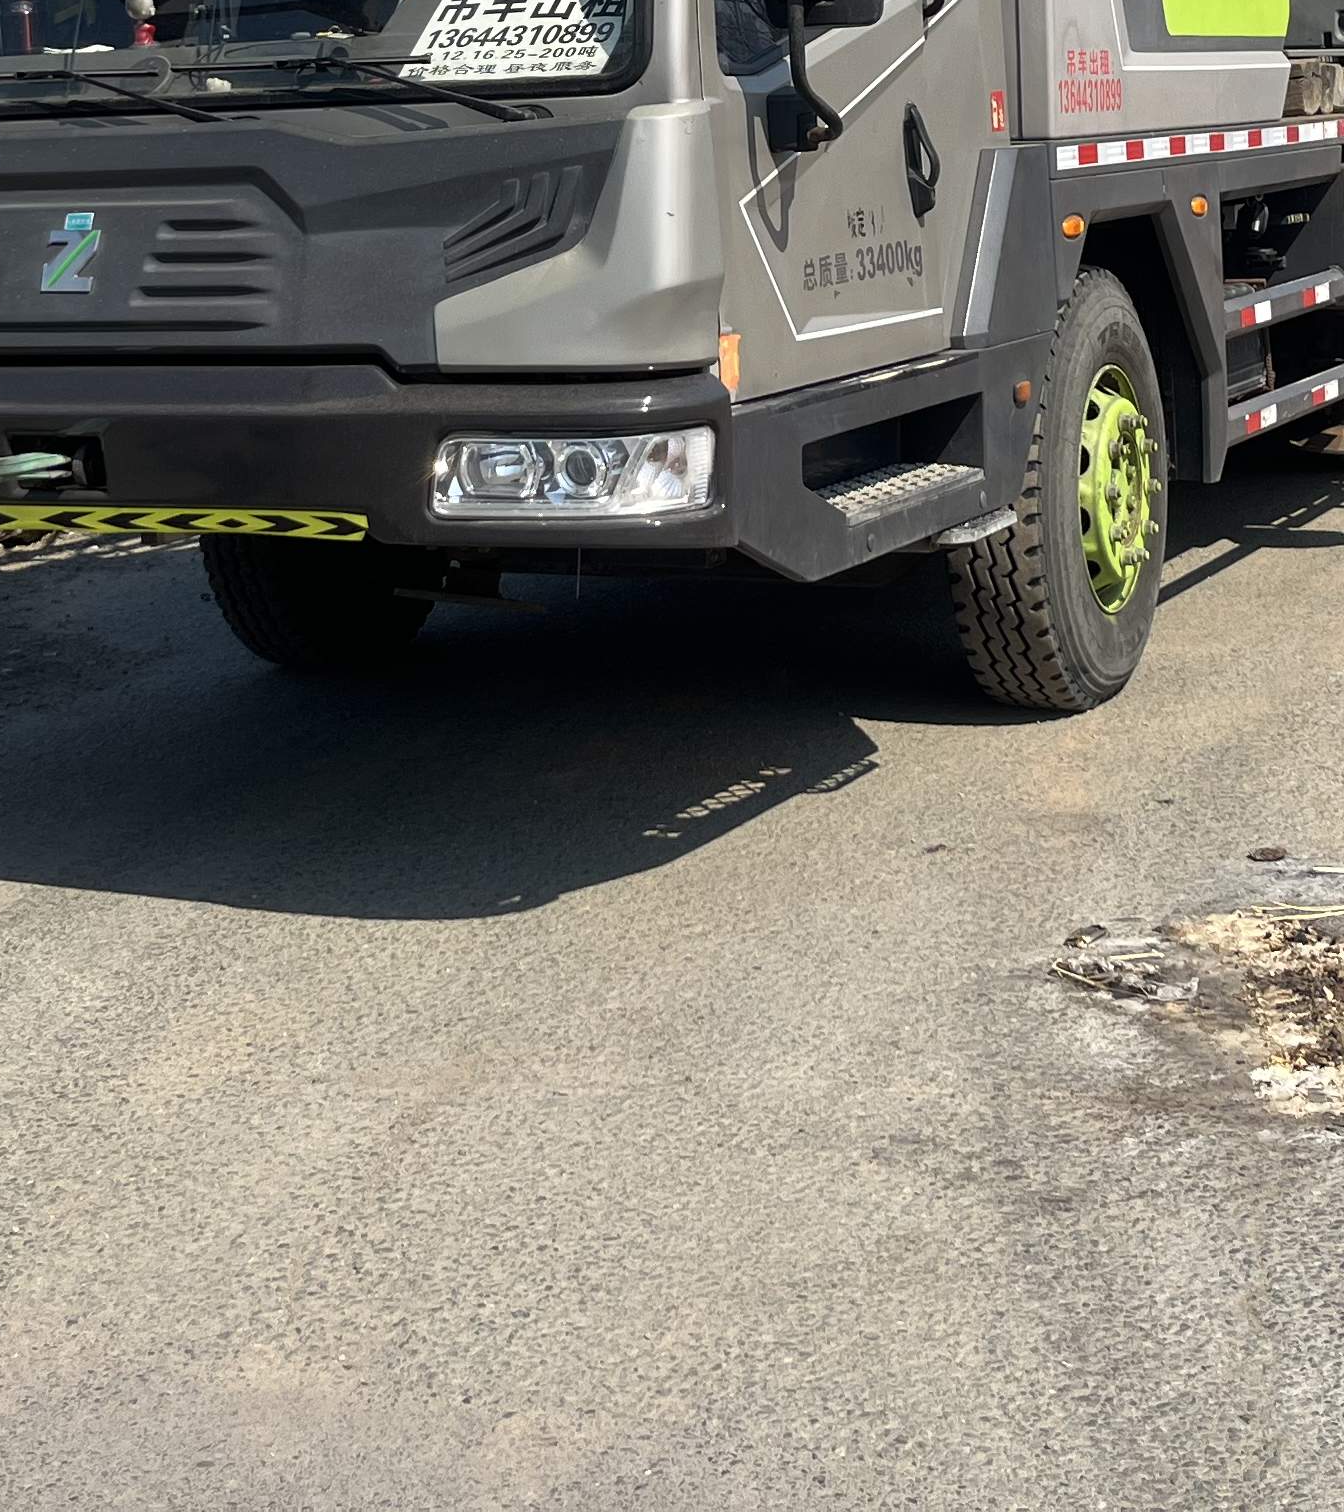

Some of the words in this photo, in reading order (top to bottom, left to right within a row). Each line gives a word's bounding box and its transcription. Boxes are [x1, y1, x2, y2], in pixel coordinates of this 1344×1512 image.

[426, 21, 614, 50] 13644310899
[408, 63, 497, 78] 价格合理
[1058, 78, 1122, 114] 13644310899
